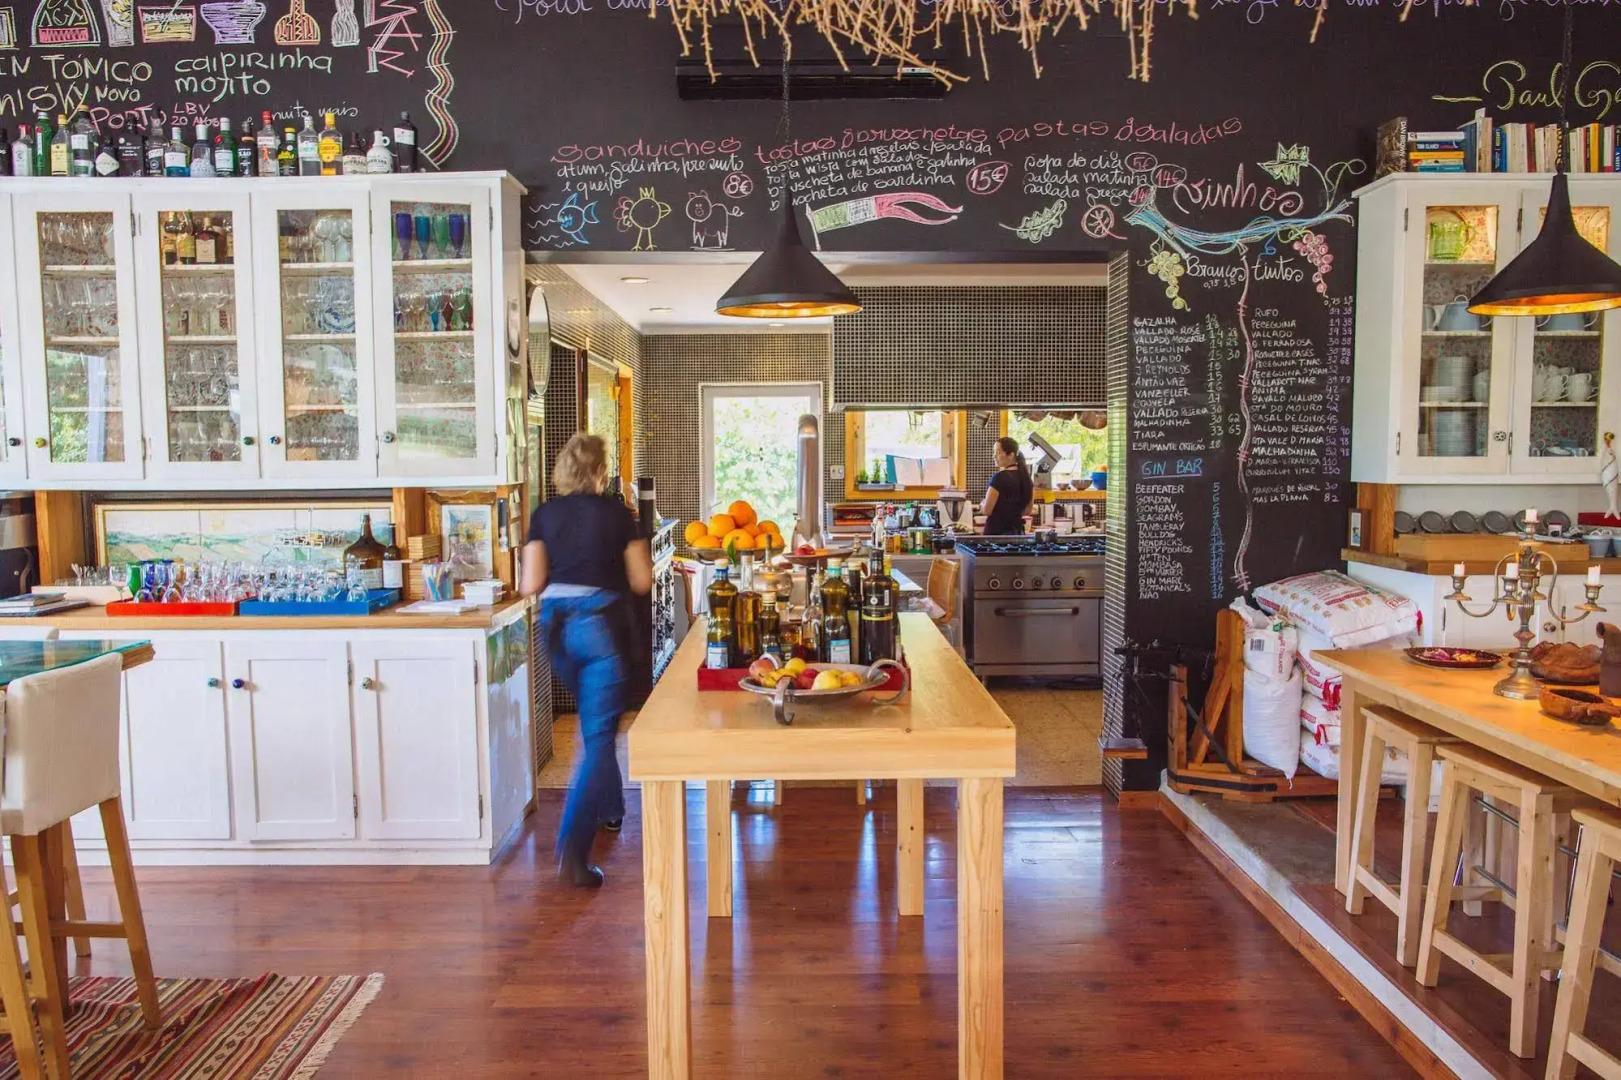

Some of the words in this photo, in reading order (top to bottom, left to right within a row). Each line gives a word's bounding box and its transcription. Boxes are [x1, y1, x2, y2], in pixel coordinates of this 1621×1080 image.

[174, 101, 211, 115] LBV
[172, 115, 189, 126] 20
[996, 120, 1109, 149] pastas
[1136, 117, 1242, 145] saladas
[1067, 152, 1086, 168] do
[1090, 151, 1124, 169] dia
[1254, 307, 1279, 318] RUFO
[1134, 327, 1175, 336] VALLADO
[1251, 330, 1293, 338] VALLADO
[1135, 354, 1182, 364] VALLADO
[1251, 386, 1286, 395] ANIMA
[1133, 407, 1180, 419] VALLADO
[1270, 405, 1283, 413] DO
[1285, 403, 1323, 412] MOURO
[1251, 413, 1283, 422] CASAL
[1253, 423, 1289, 433] VALLADO
[1133, 430, 1166, 440] TIARA
[1251, 446, 1318, 457] MALHADINHA
[1141, 460, 1166, 476] GIN
[1176, 458, 1203, 475] BAR
[1135, 483, 1184, 494] BEEFEATER
[1212, 482, 1220, 492] 5
[1269, 495, 1280, 503] LA
[1280, 493, 1309, 503] PLANA
